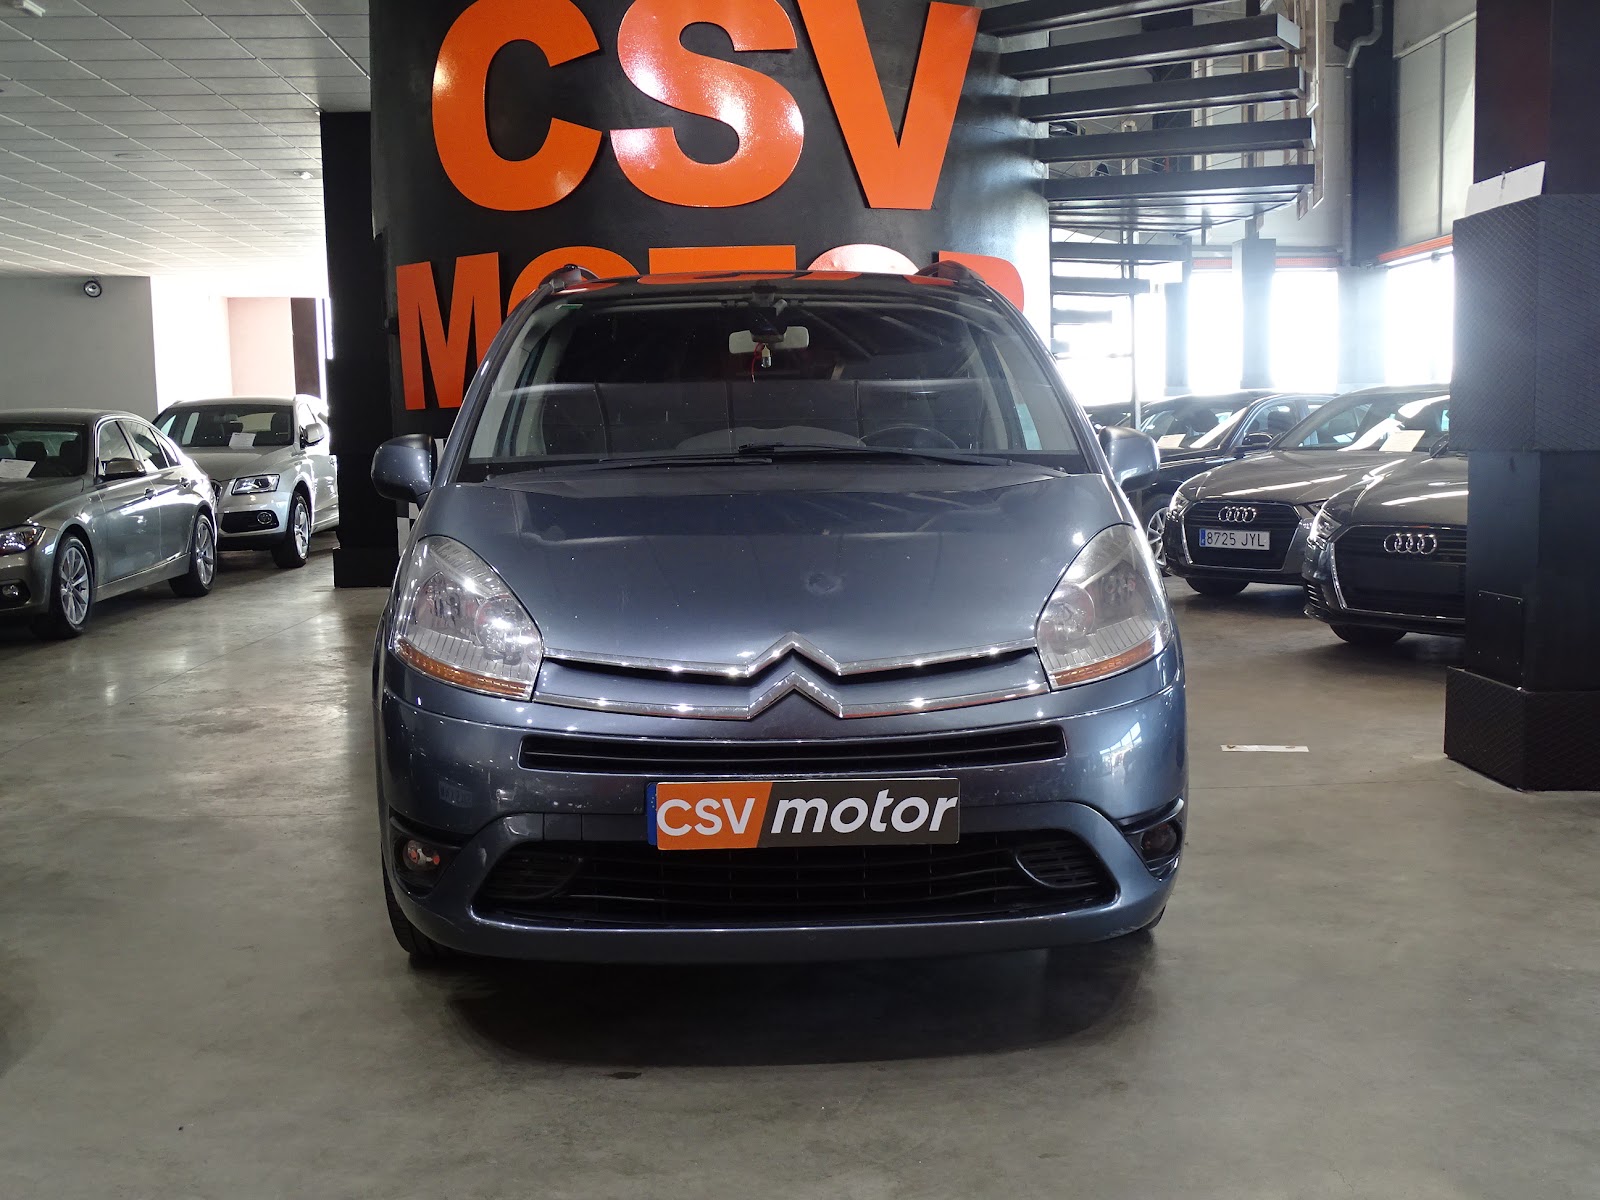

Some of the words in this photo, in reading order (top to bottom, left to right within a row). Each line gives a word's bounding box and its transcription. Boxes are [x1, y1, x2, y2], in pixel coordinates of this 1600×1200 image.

[432, 0, 981, 211] CSV
[1206, 531, 1236, 546] 8725
[1241, 532, 1265, 547] JYL
[656, 798, 755, 836] CSV
[770, 788, 958, 833] motor
